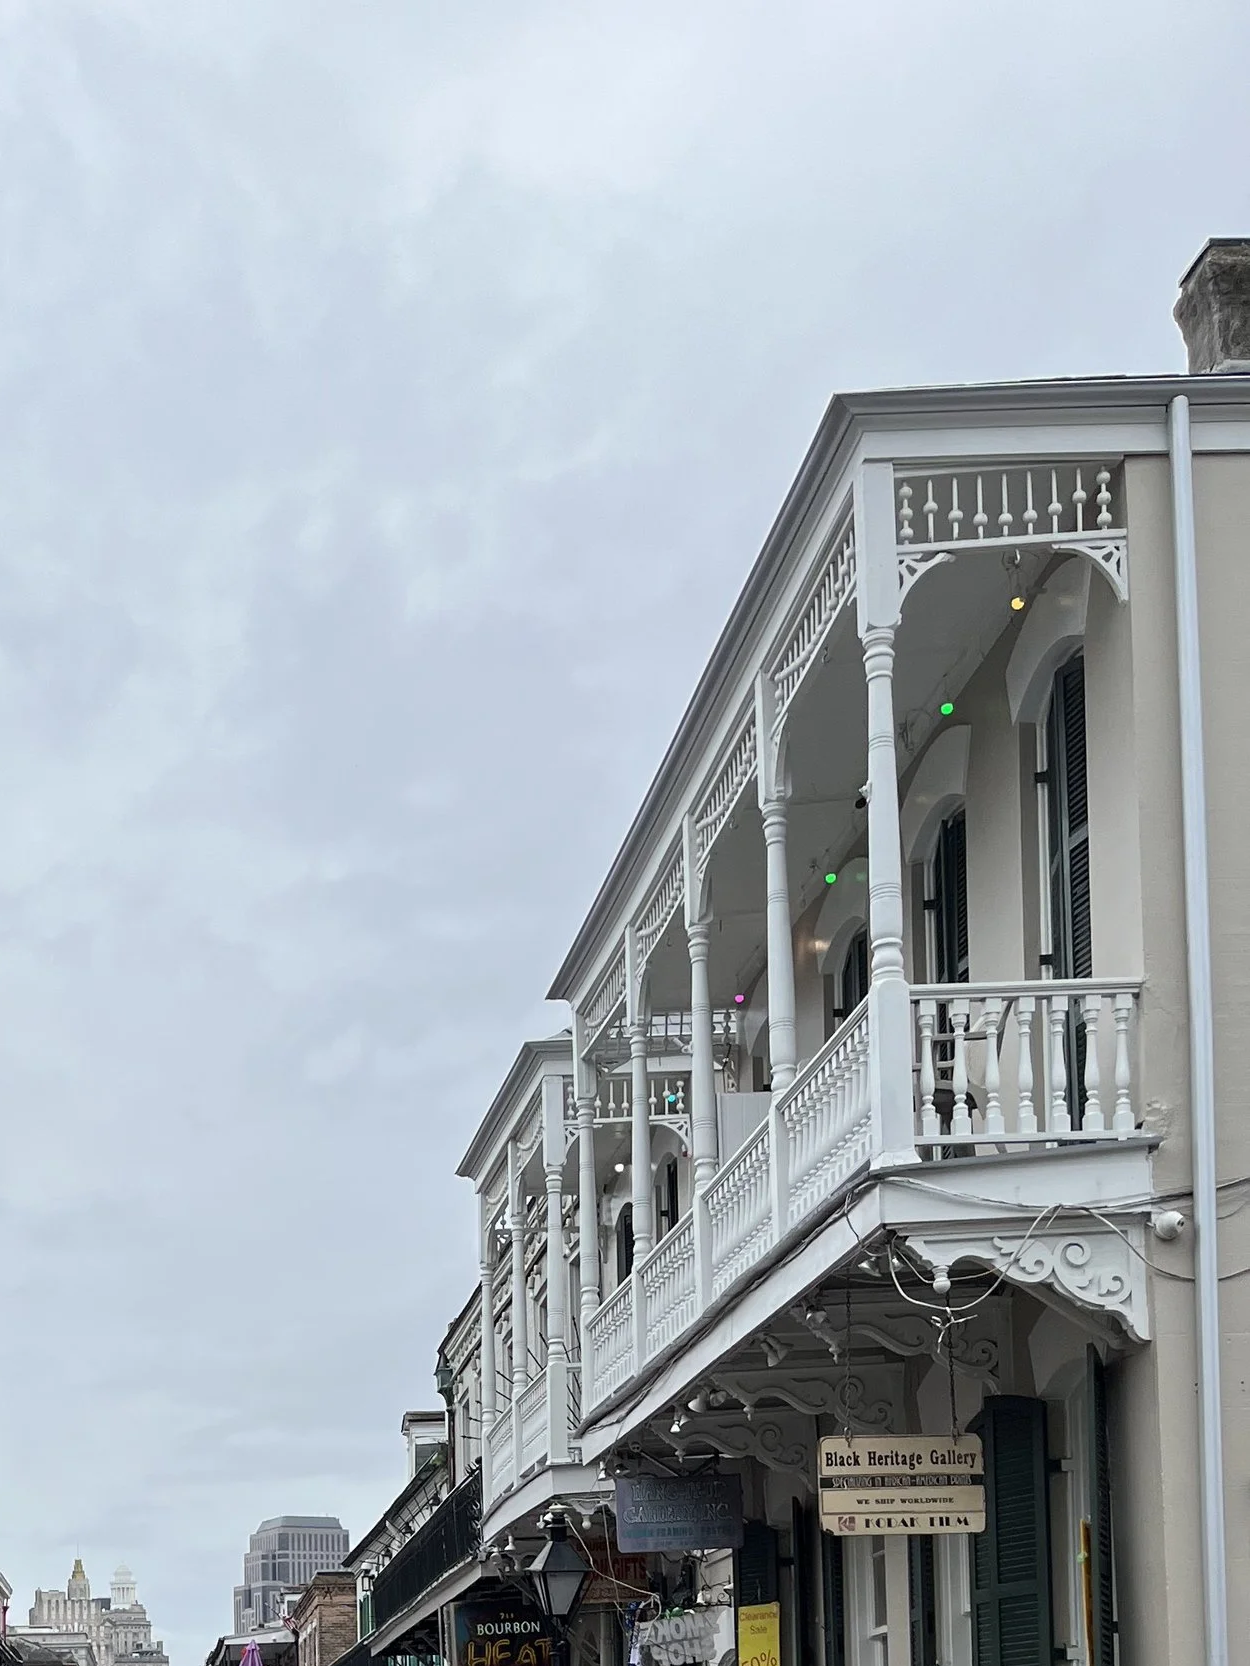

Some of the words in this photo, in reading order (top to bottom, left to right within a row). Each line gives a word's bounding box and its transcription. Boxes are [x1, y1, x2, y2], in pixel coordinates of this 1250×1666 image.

[825, 1451, 861, 1467] Black
[867, 1450, 923, 1471] Heritage
[930, 1449, 977, 1469] Gallery
[900, 1497, 955, 1505] WORLDWIDE
[865, 1517, 924, 1529] KODAK
[929, 1515, 970, 1528] FILM
[613, 1557, 647, 1580] GIFTS
[740, 1612, 778, 1622] Clearance
[476, 1620, 542, 1636] BOURBON
[750, 1625, 768, 1635] Sale
